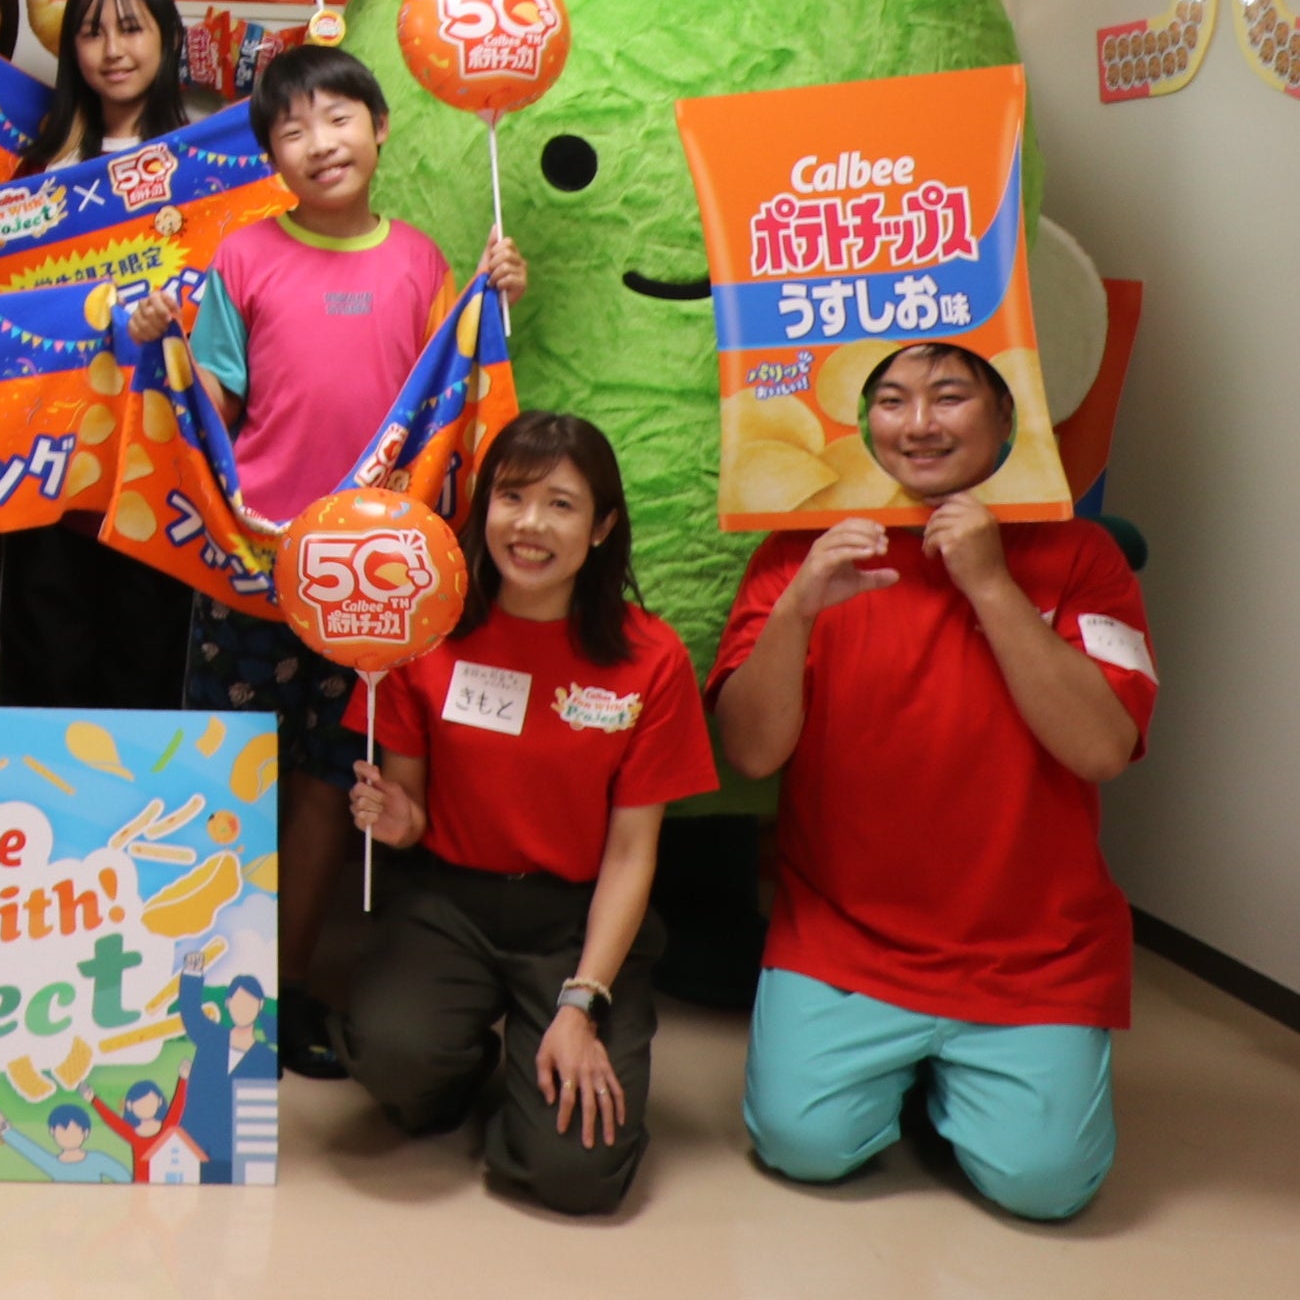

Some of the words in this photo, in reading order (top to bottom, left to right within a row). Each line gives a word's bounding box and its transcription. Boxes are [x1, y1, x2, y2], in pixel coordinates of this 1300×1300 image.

[790, 151, 916, 194] Calbee
[749, 179, 980, 277] ポテトチップス
[778, 274, 973, 339] うすしお味
[303, 538, 416, 602] 50
[327, 611, 400, 635] ポテトチップス
[341, 600, 384, 613] Calbee
